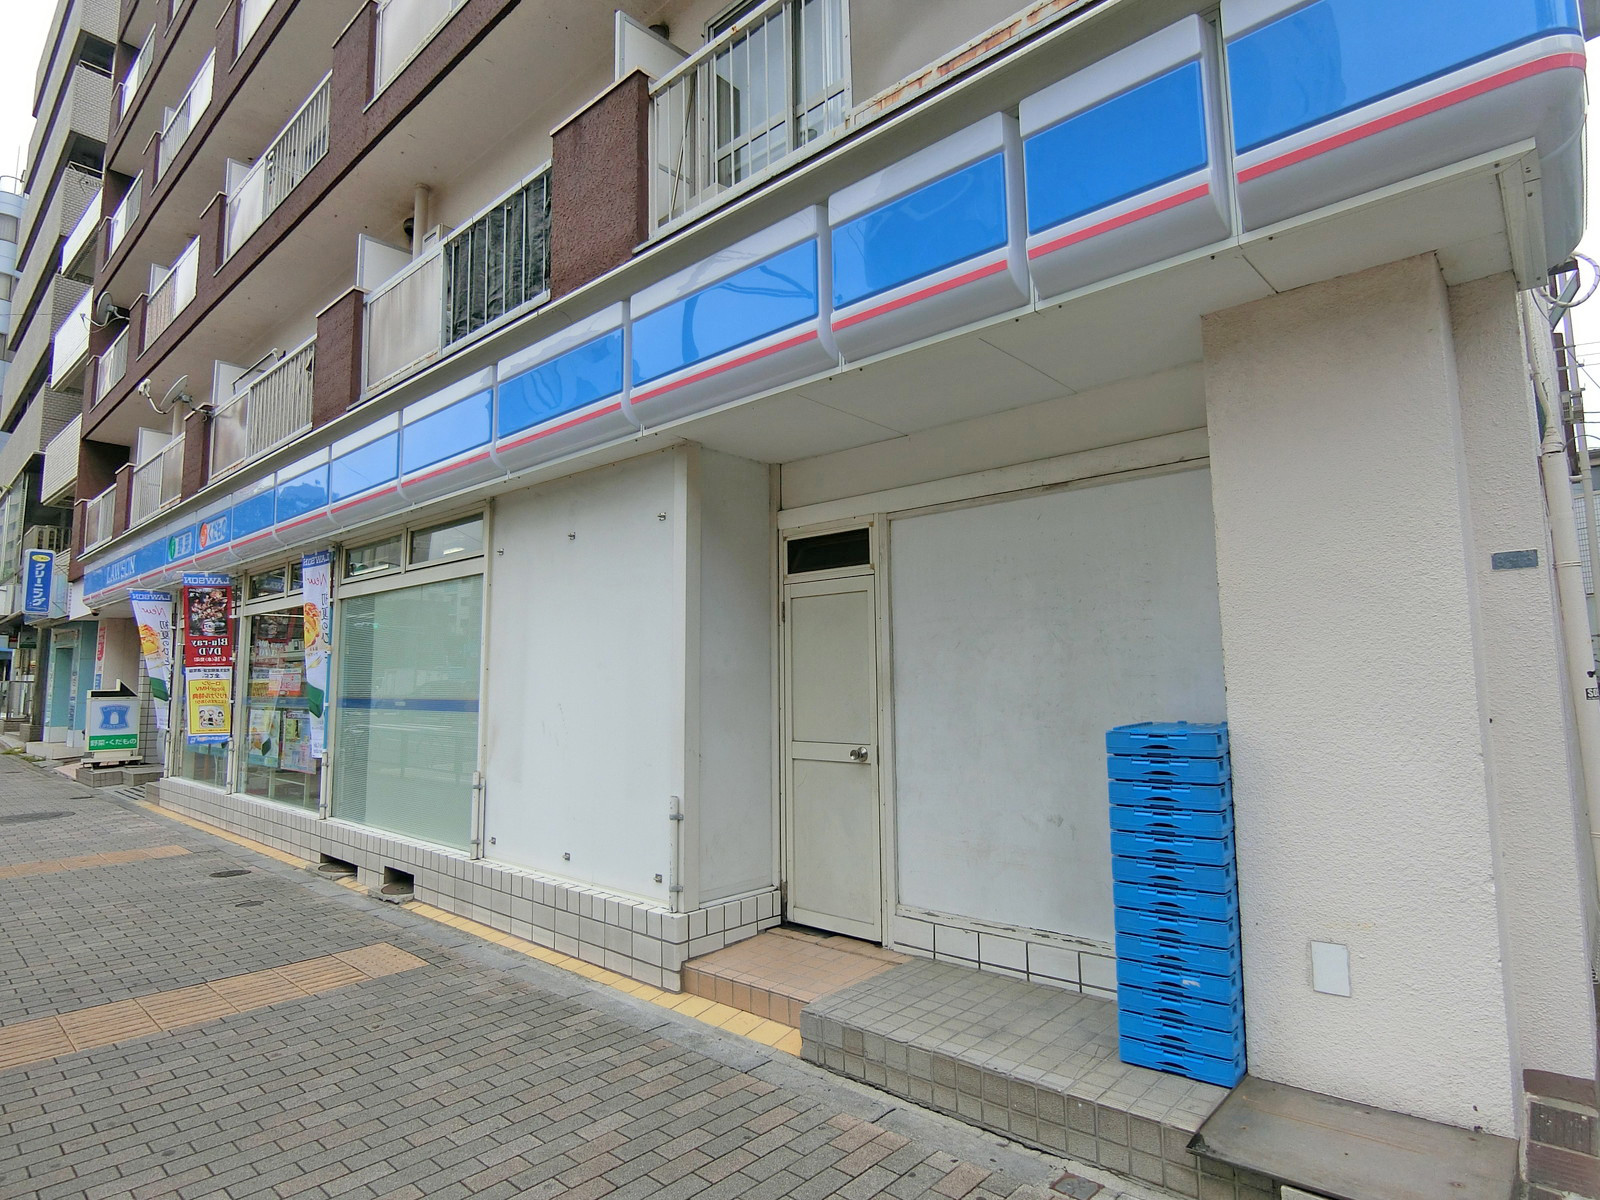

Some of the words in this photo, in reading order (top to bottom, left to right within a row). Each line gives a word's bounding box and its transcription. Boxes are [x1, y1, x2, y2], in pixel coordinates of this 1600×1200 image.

[32, 562, 46, 606] クリーニング
[105, 554, 136, 584] LAWSON
[90, 738, 136, 746] 野菜・くだもの
